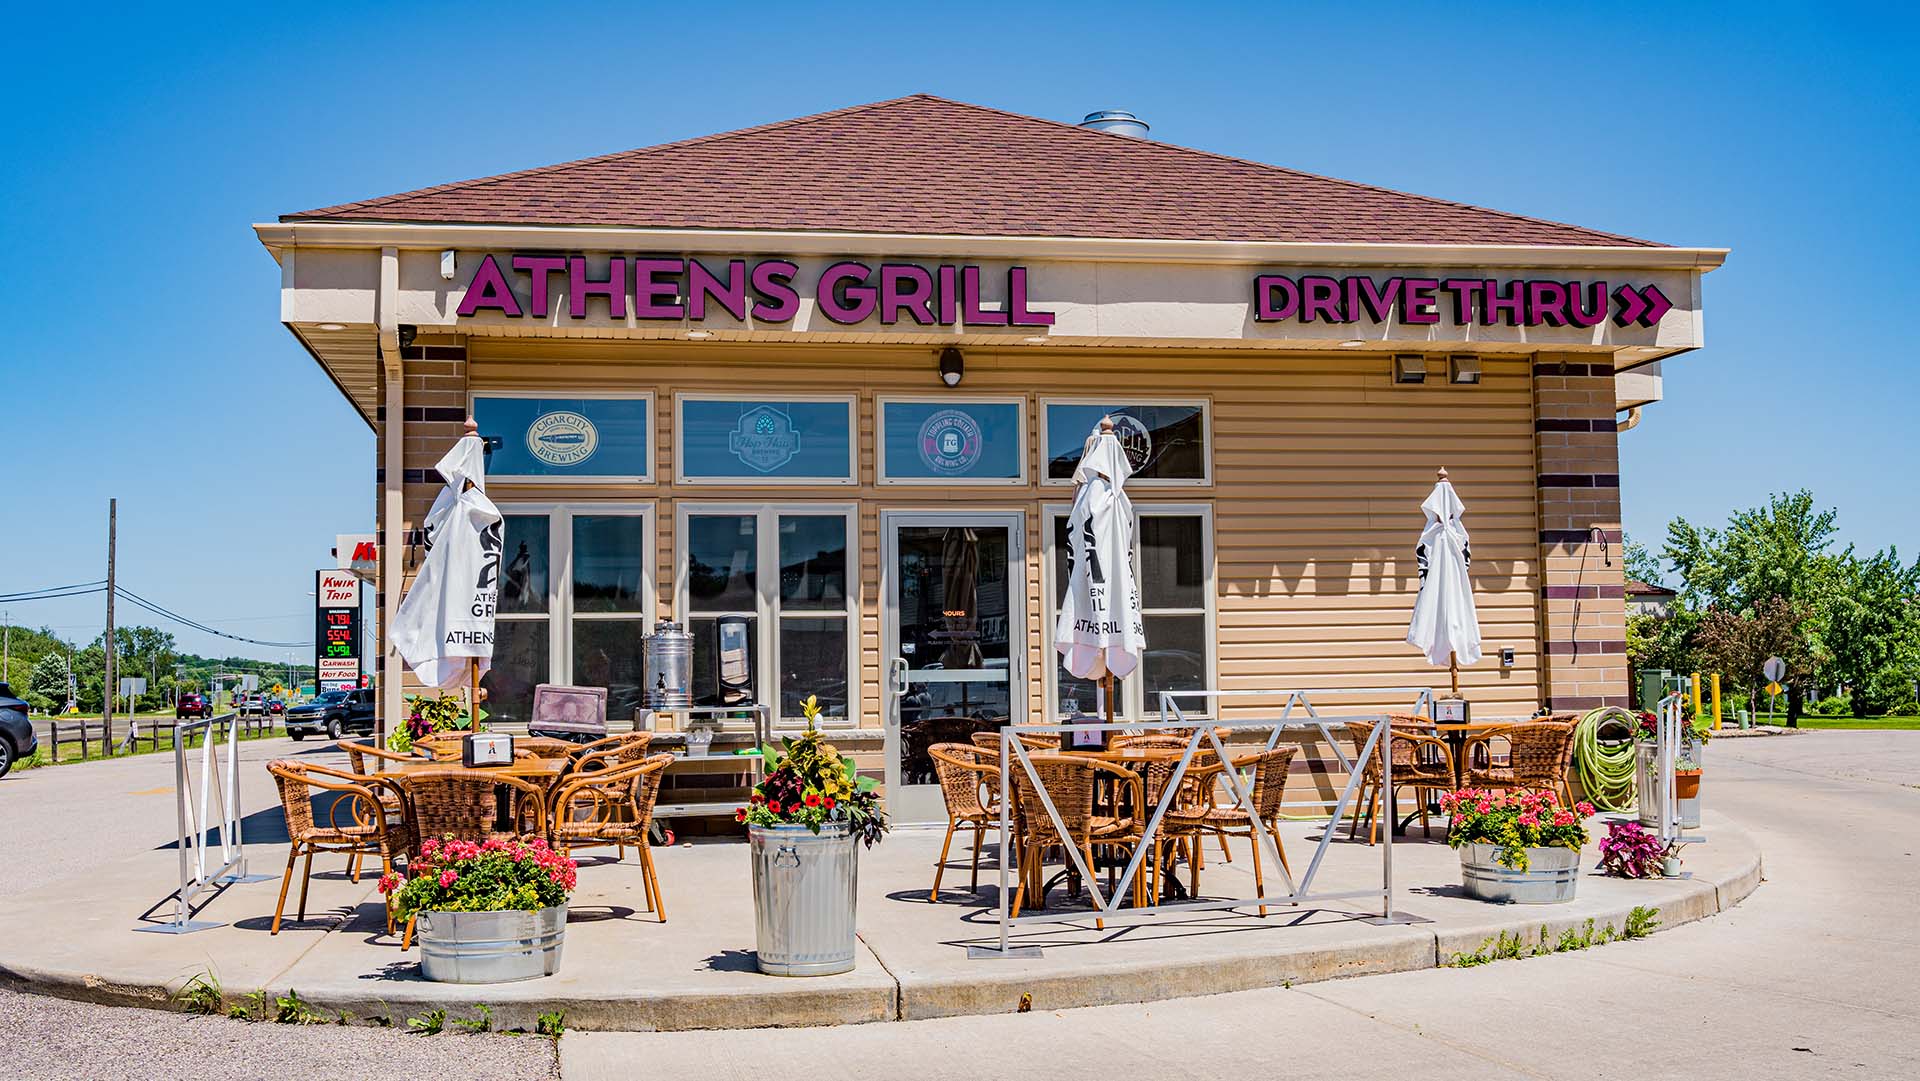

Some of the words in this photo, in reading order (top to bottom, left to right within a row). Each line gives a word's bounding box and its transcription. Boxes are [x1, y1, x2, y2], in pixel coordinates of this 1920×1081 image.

[456, 254, 799, 323] ATHENS
[817, 260, 1055, 326] GRILL
[1254, 275, 1440, 324] DRIVE
[1440, 278, 1607, 328] THRU
[536, 415, 566, 431] CIGAR
[566, 415, 589, 430] CITY
[944, 439, 957, 447] TG
[537, 446, 588, 462] BREWING
